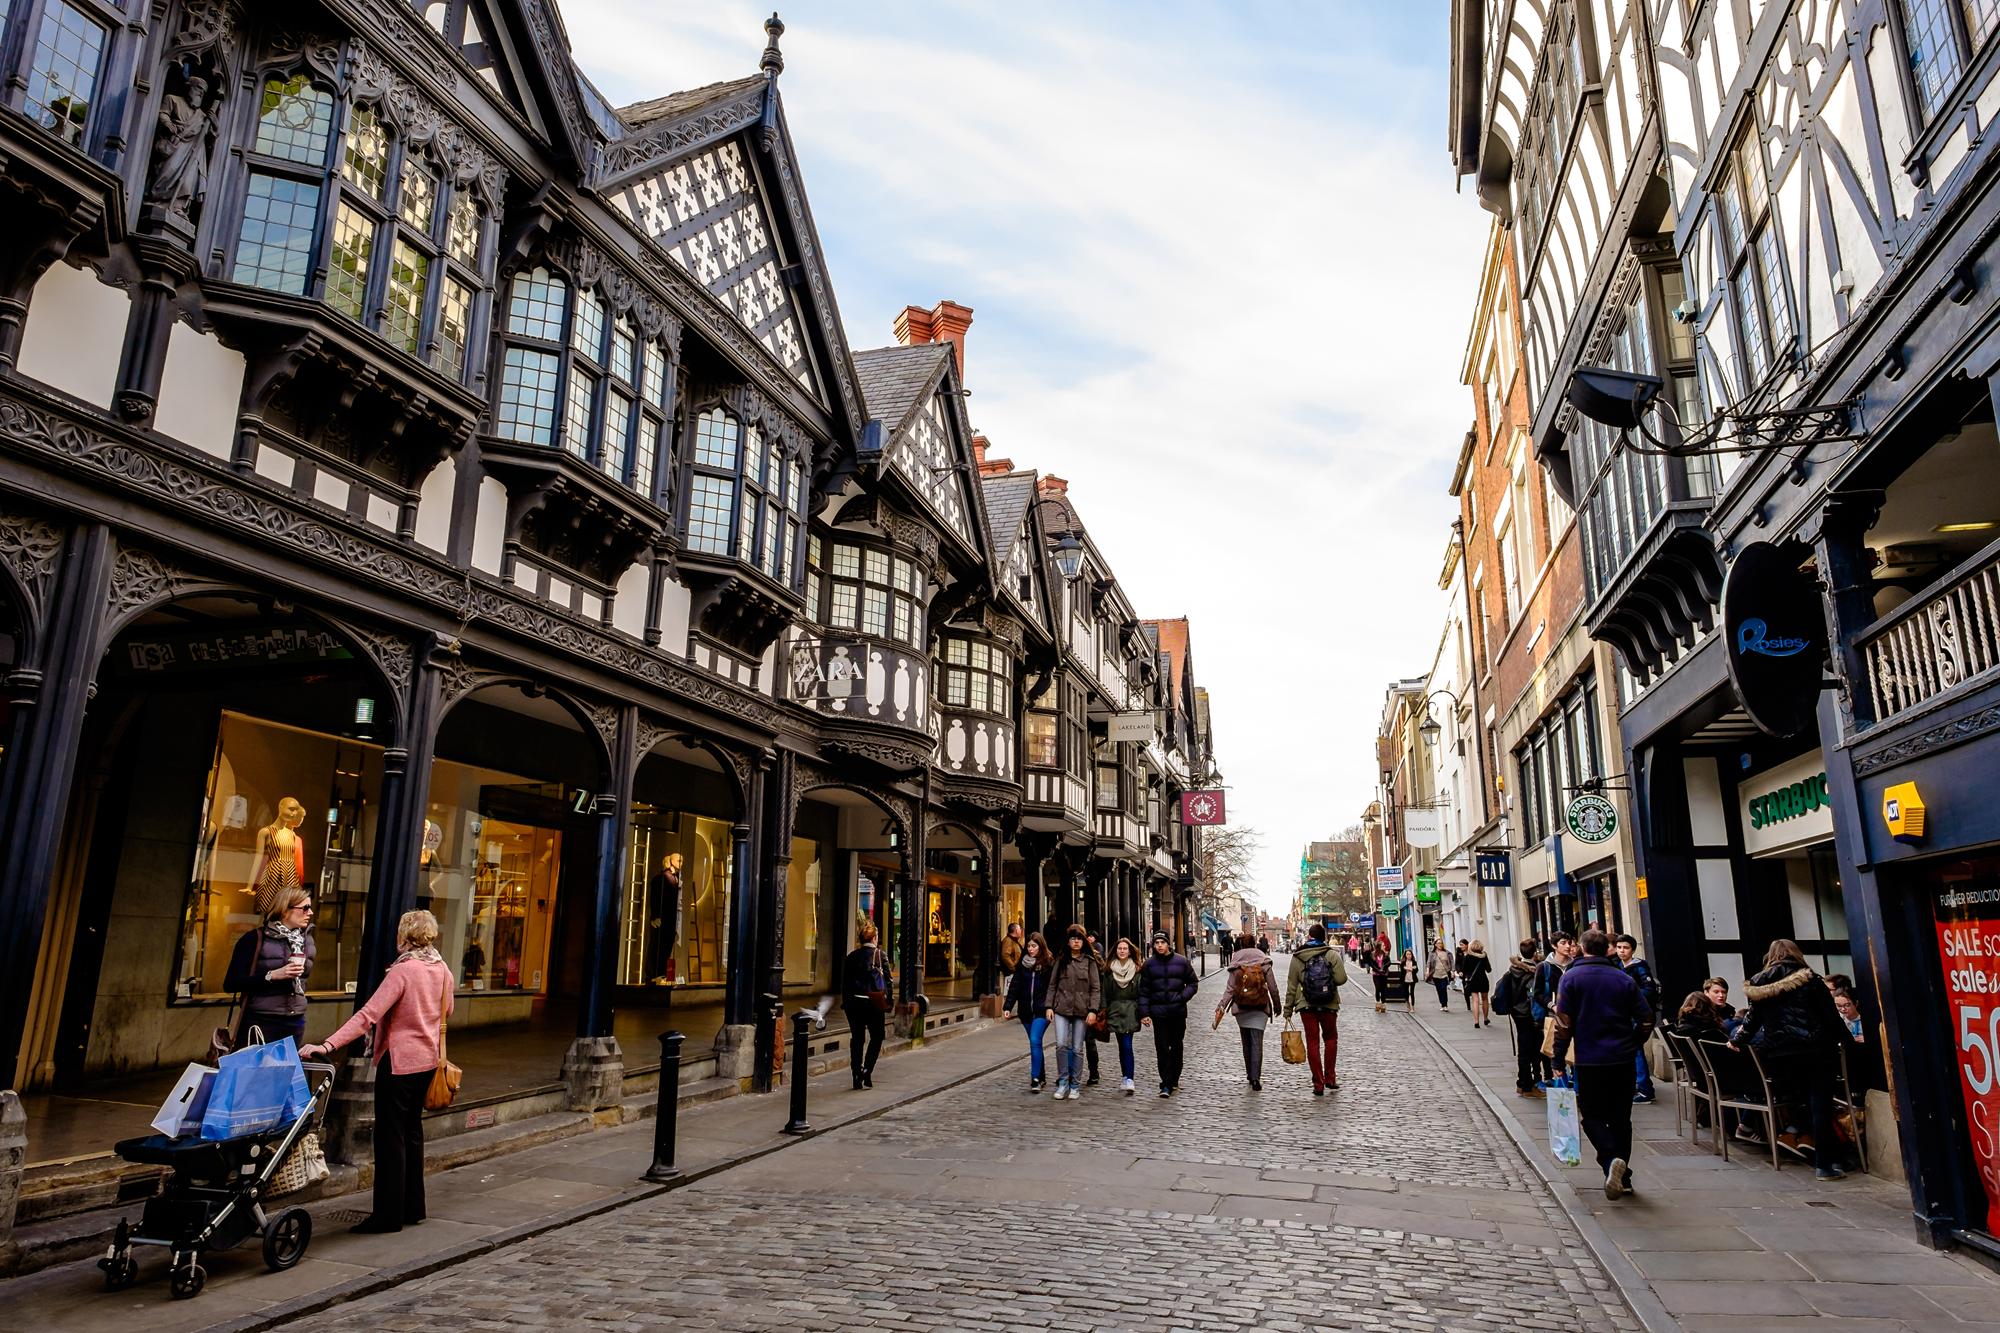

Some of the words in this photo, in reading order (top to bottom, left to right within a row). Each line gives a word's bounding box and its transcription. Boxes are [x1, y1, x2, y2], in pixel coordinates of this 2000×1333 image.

[1738, 617, 1810, 657] Rosies
[794, 660, 865, 682] ZARA
[1569, 797, 1614, 818] STARBUCKS
[1575, 827, 1611, 840] COFFEE
[1481, 861, 1505, 880] GAP
[1966, 888, 2000, 905] REDUCTIO
[1944, 928, 1983, 957] SALE
[1950, 962, 1988, 994] sale
